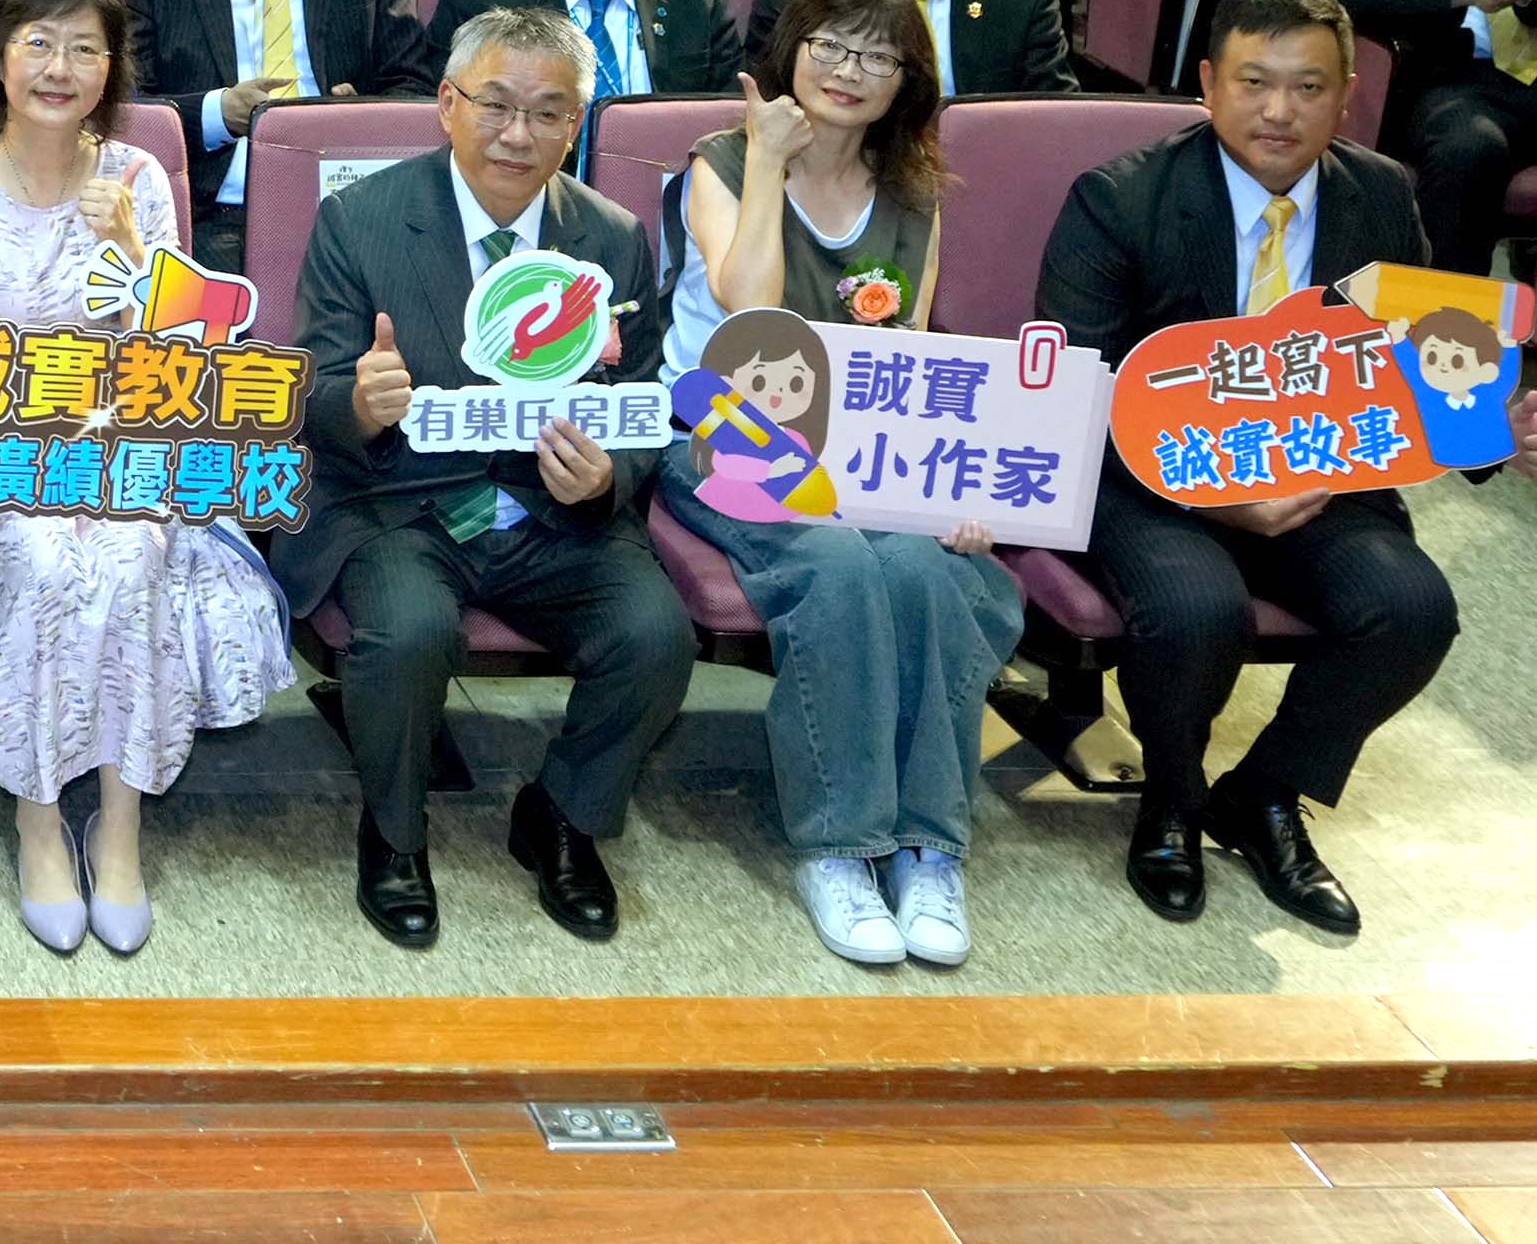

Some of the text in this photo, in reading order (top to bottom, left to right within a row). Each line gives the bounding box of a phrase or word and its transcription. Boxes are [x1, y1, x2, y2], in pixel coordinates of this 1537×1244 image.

[843, 350, 991, 425] 誠實
[1147, 328, 1396, 403] 一起寫下
[411, 394, 661, 444] 有巢氏房屋
[1156, 406, 1413, 492] 誠實故事
[845, 431, 1062, 508] 小作家
